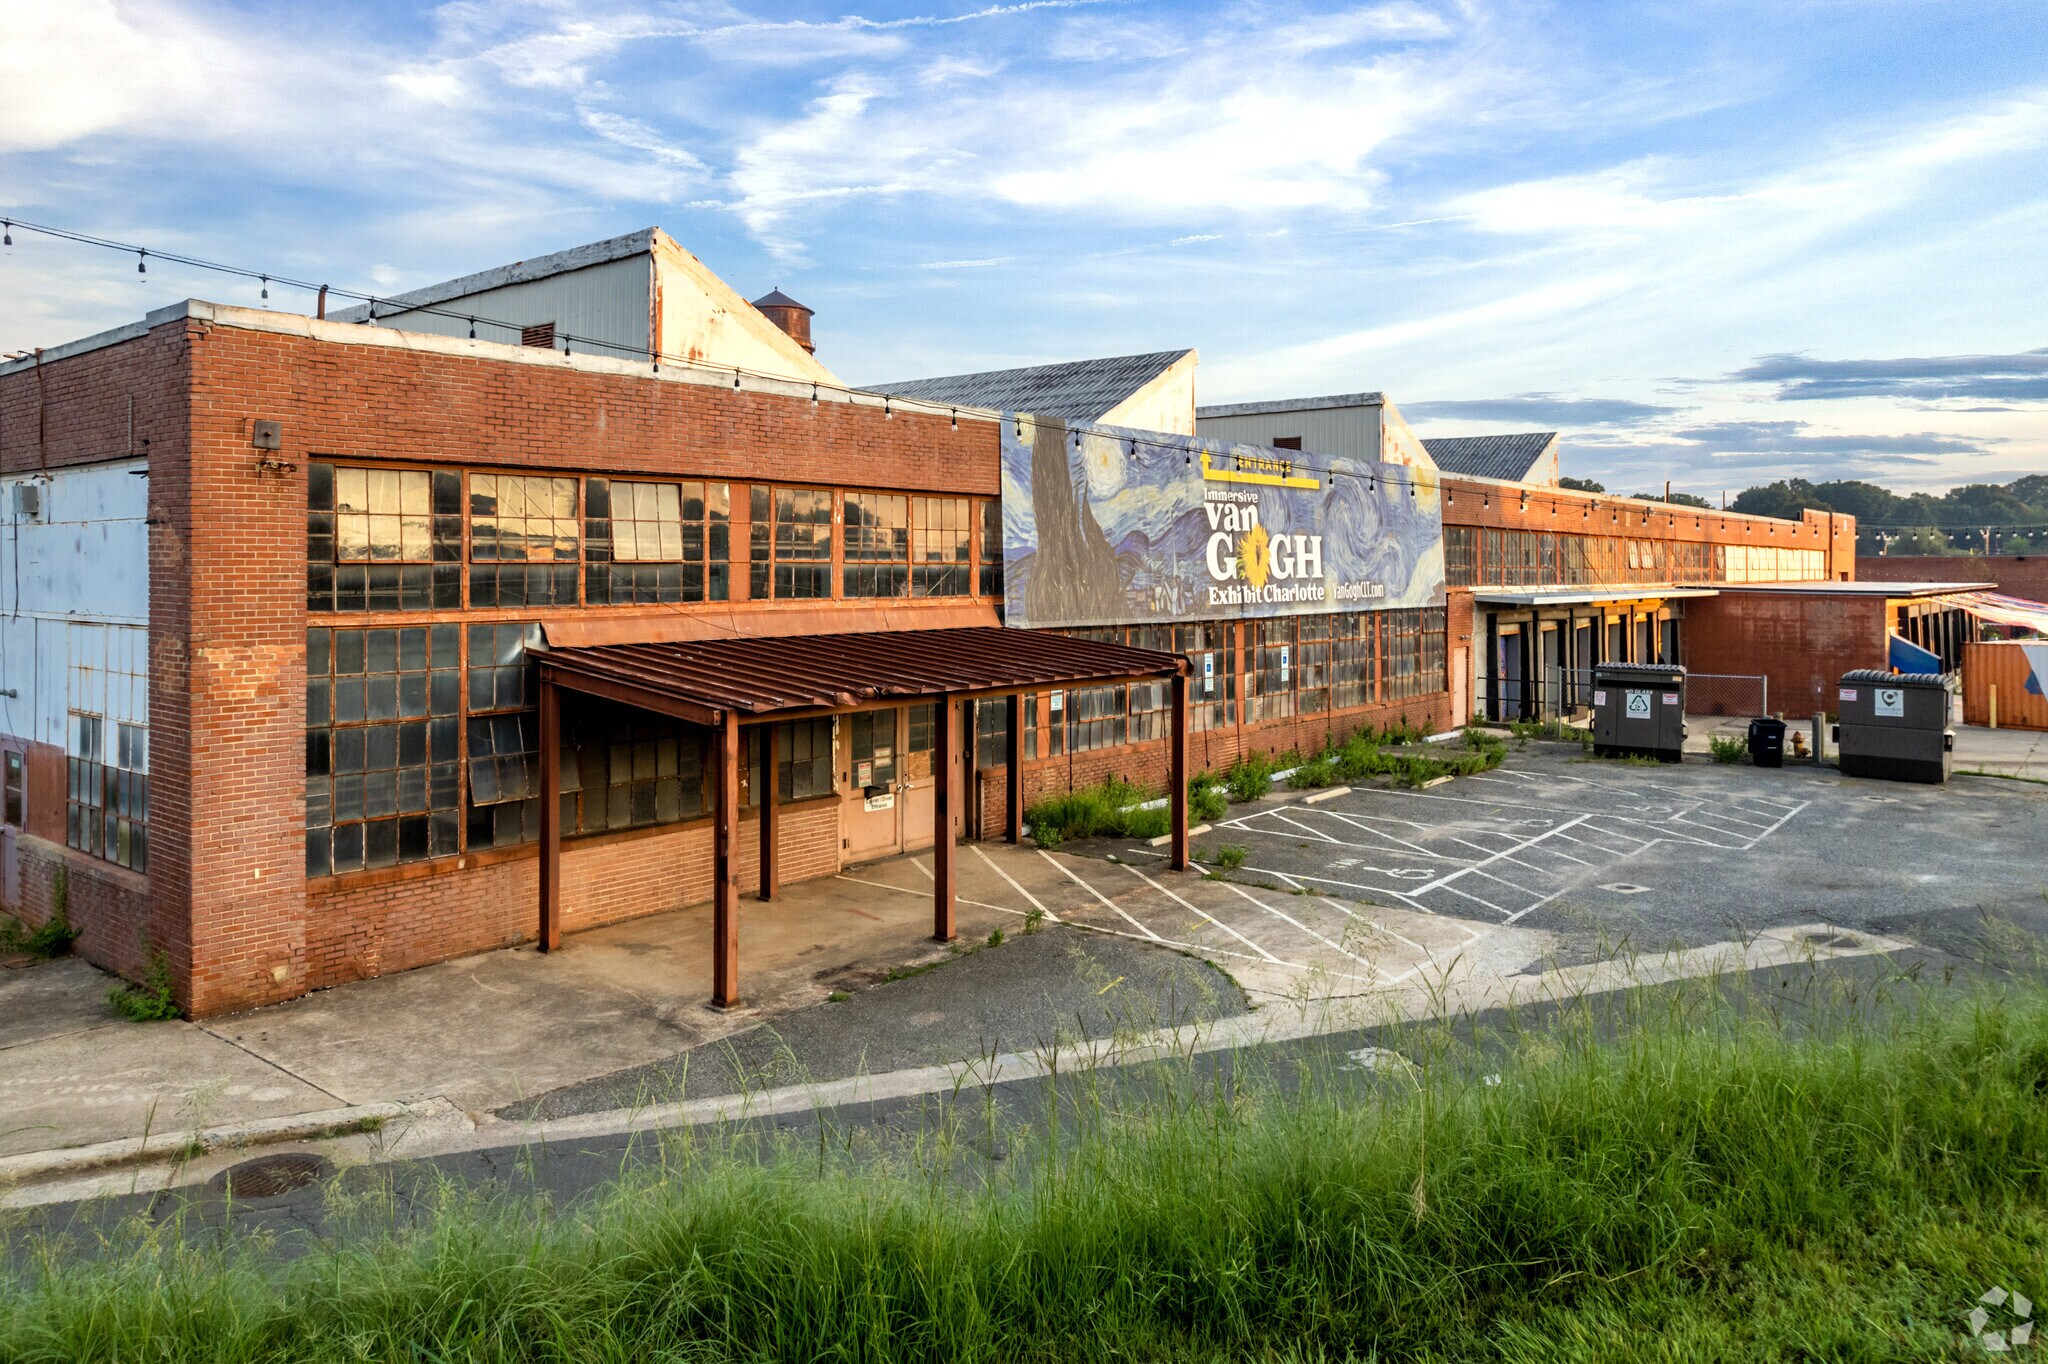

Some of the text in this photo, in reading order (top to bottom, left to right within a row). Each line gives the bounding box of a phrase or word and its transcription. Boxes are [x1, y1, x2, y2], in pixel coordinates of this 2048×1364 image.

[1238, 456, 1292, 473] ENTRANCE
[1203, 487, 1258, 503] Immersive
[1203, 502, 1259, 532] van
[1208, 582, 1325, 605] Exhibit Charlotte
[1332, 581, 1385, 602] VanGoghCLT.com
